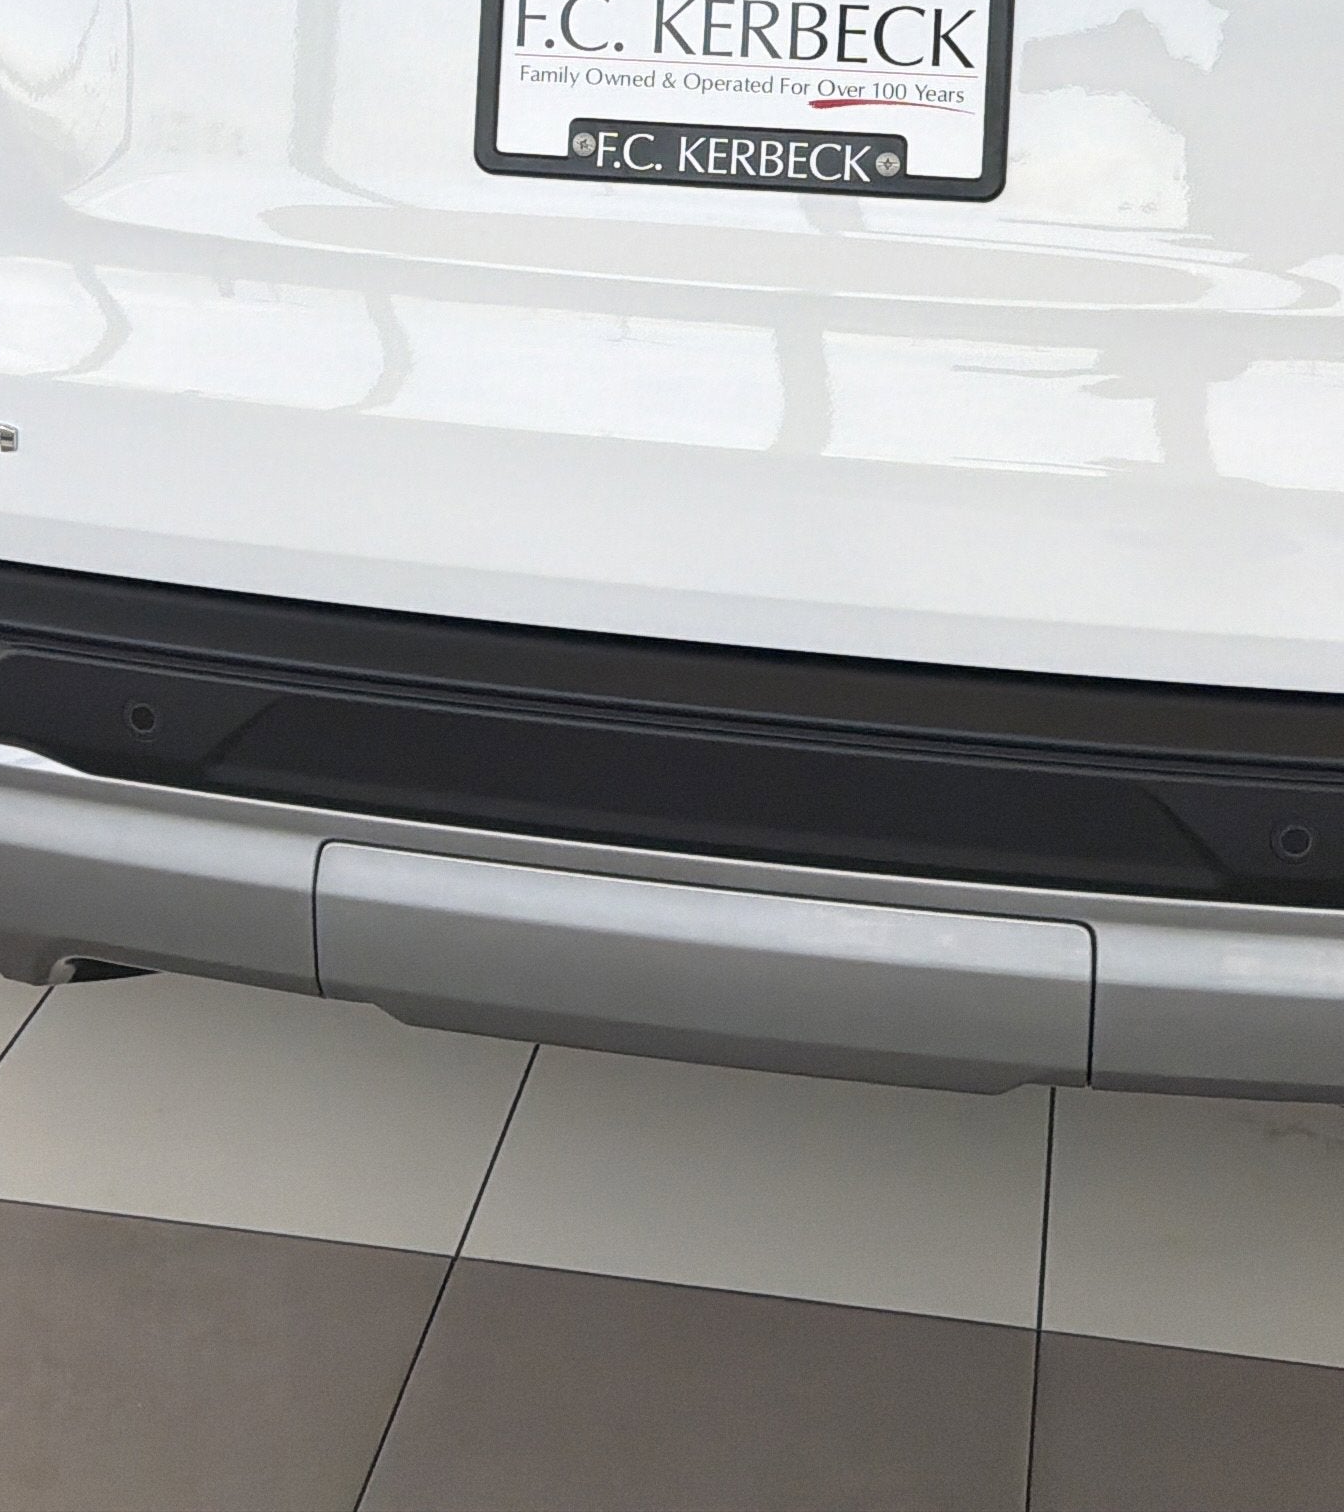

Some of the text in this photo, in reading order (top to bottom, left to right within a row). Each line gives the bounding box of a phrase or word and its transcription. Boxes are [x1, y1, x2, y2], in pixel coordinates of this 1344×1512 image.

[520, 65, 965, 104] Family Owned & Operated For Over 100 Years
[596, 131, 873, 183] F.C. KERBECK
